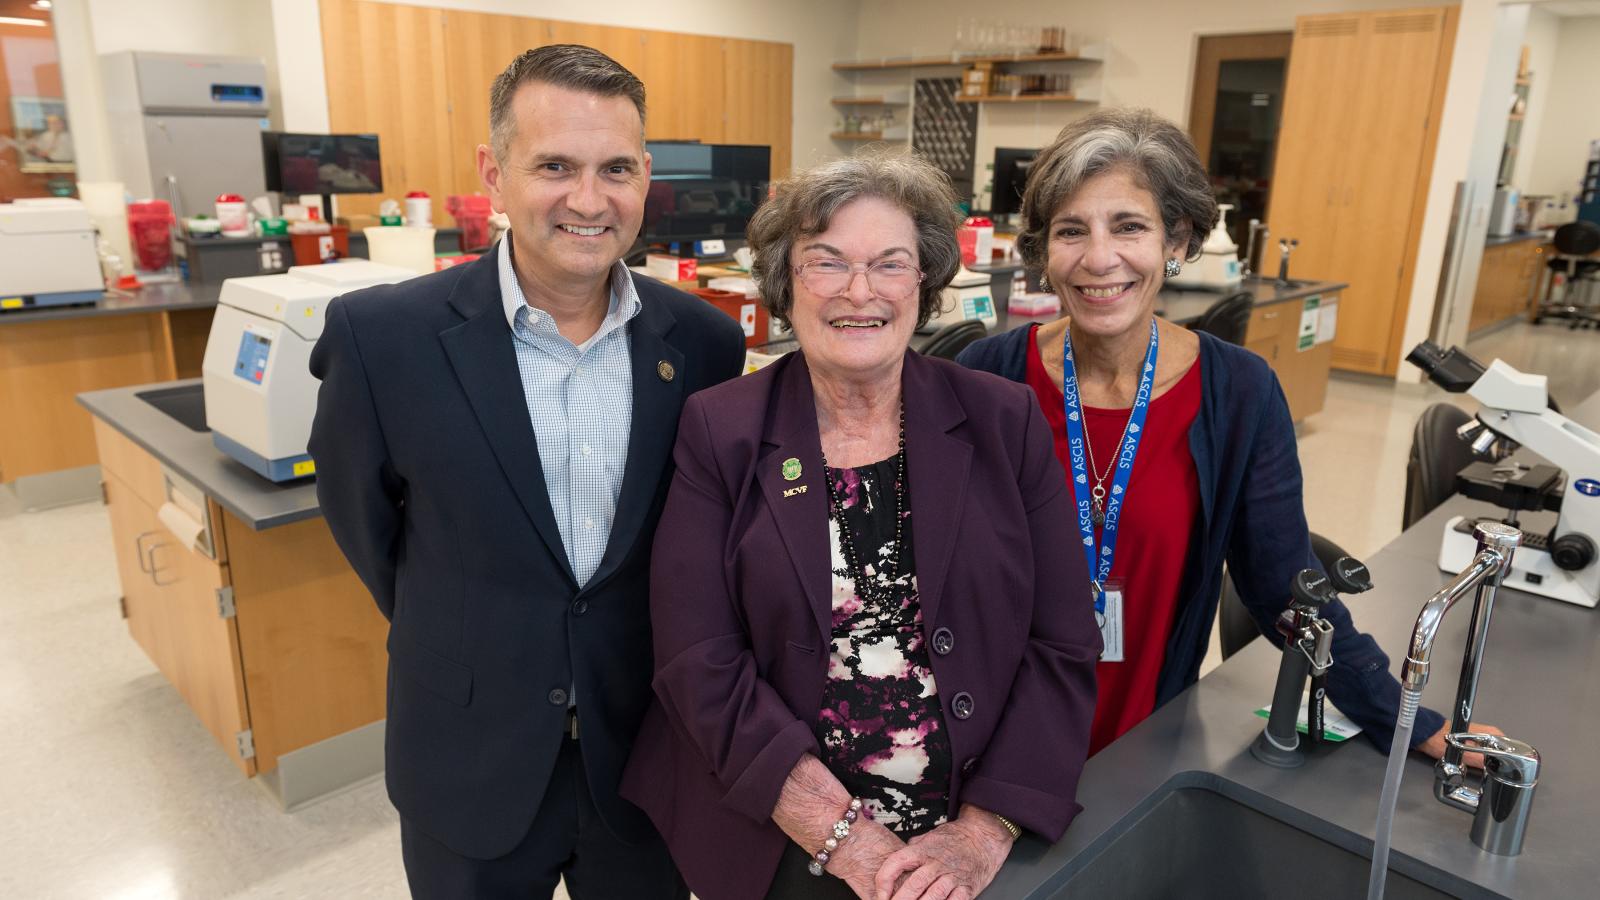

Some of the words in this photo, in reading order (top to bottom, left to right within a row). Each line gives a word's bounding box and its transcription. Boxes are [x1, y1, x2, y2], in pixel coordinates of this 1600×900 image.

[1066, 376, 1078, 408] ASCLS
[1137, 373, 1151, 408] ASCLS
[1071, 437, 1085, 471] ASCLS
[1119, 435, 1136, 469] ASCLS
[1079, 500, 1092, 533] ASCLS
[1105, 497, 1119, 531] ASCLS
